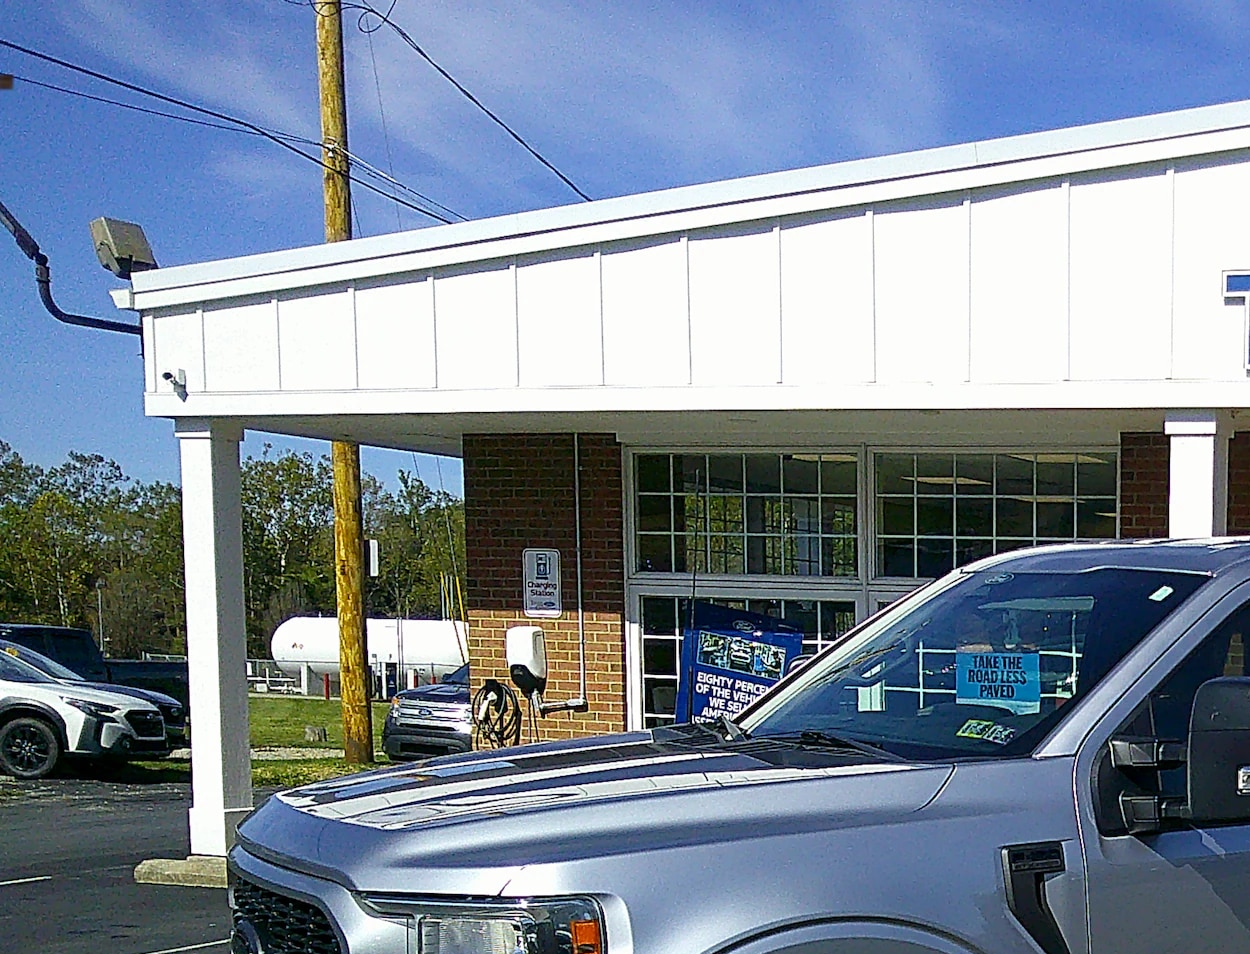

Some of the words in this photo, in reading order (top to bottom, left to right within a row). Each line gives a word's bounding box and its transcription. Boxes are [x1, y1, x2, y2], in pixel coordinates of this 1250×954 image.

[528, 581, 557, 590] Charging
[531, 589, 554, 597] Station
[972, 656, 1000, 669] TAKE
[1001, 656, 1022, 670] THE
[697, 672, 733, 688] EIGHTY
[968, 669, 999, 684] ROAD
[1001, 670, 1027, 685] LESS
[696, 683, 710, 694] OF
[711, 686, 731, 699] THE
[980, 685, 1015, 698] PAVED
[709, 697, 726, 709] WE
